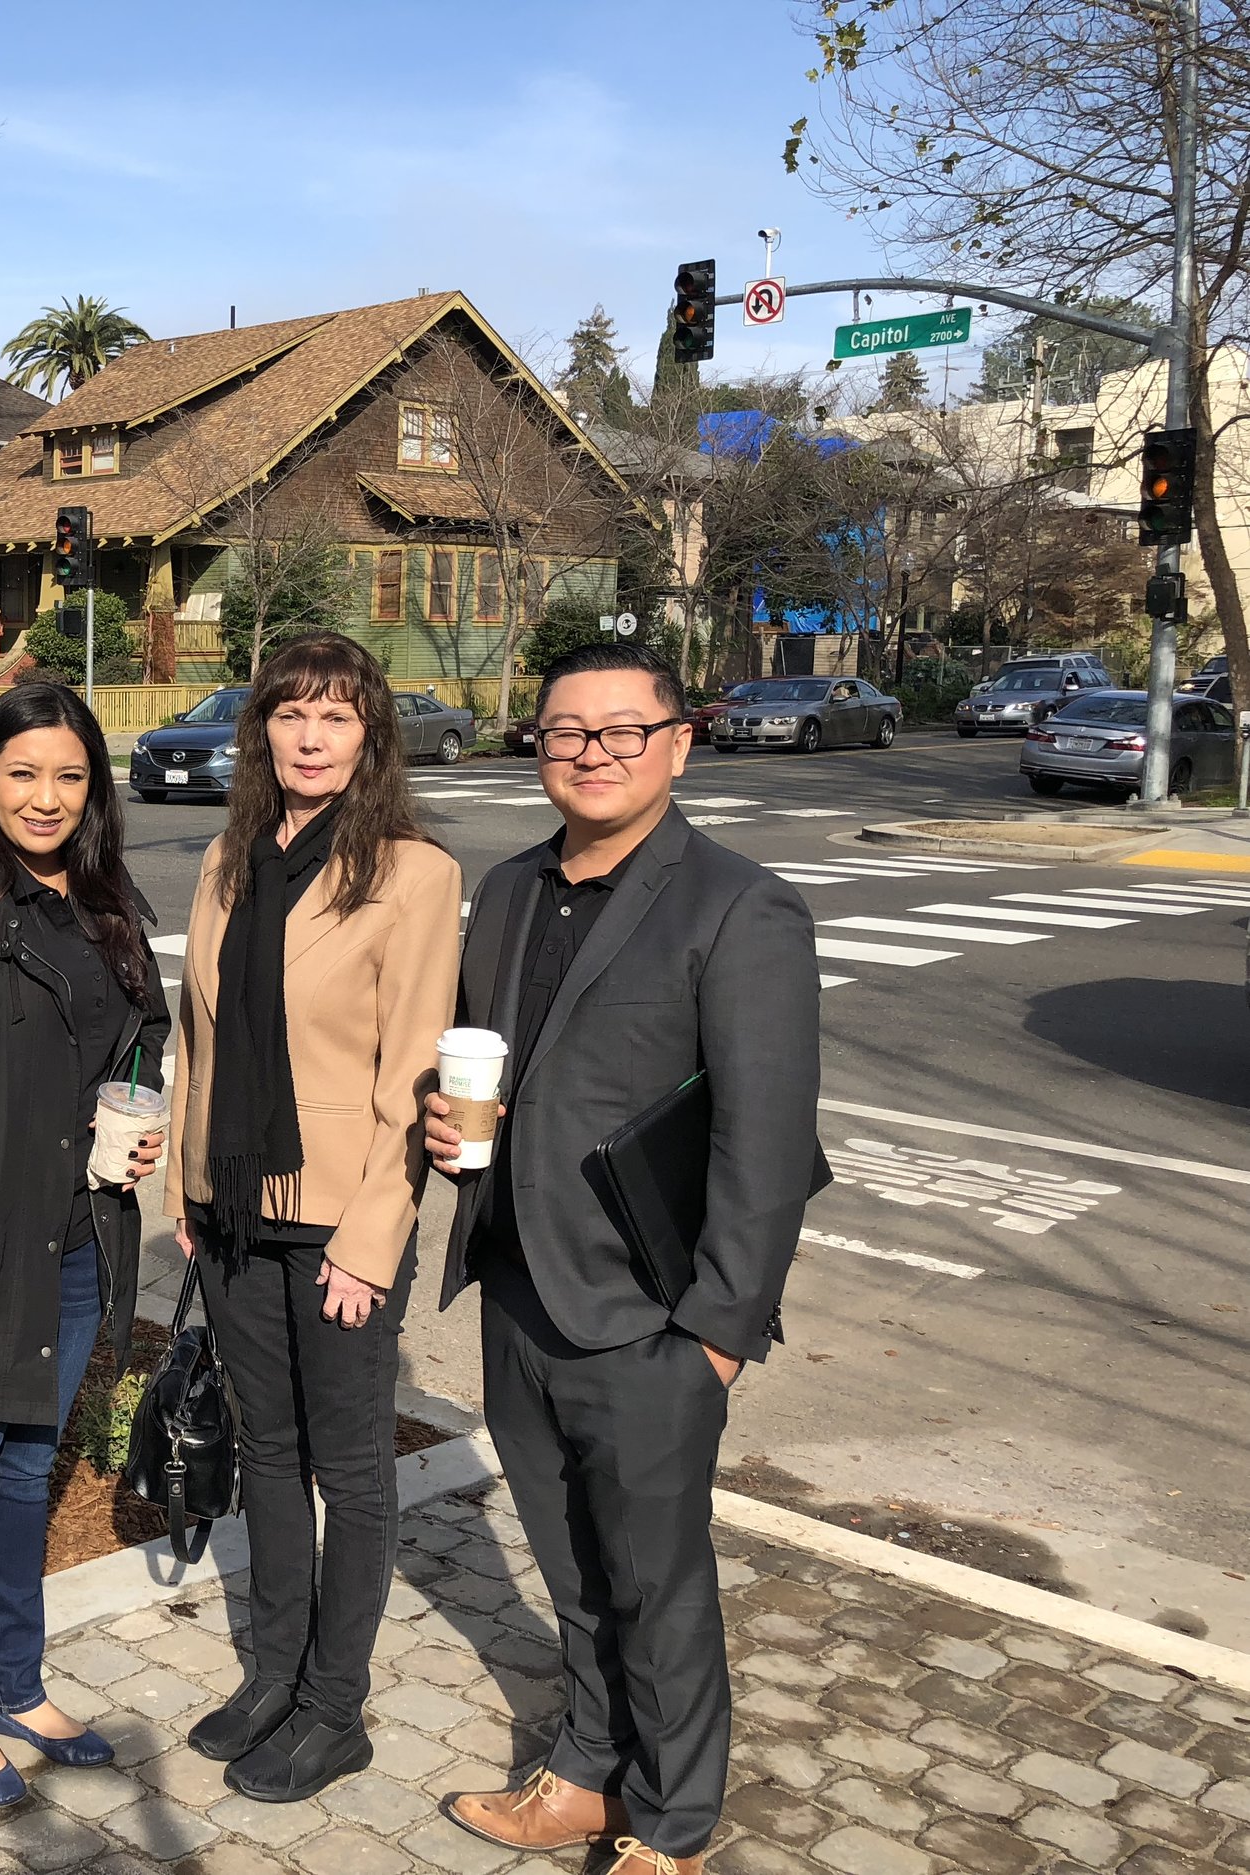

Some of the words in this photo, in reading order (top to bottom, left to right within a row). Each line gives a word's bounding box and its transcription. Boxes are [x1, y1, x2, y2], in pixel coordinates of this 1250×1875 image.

[940, 313, 956, 326] AVE
[850, 324, 909, 351] Capitol
[929, 330, 952, 343] 2700
